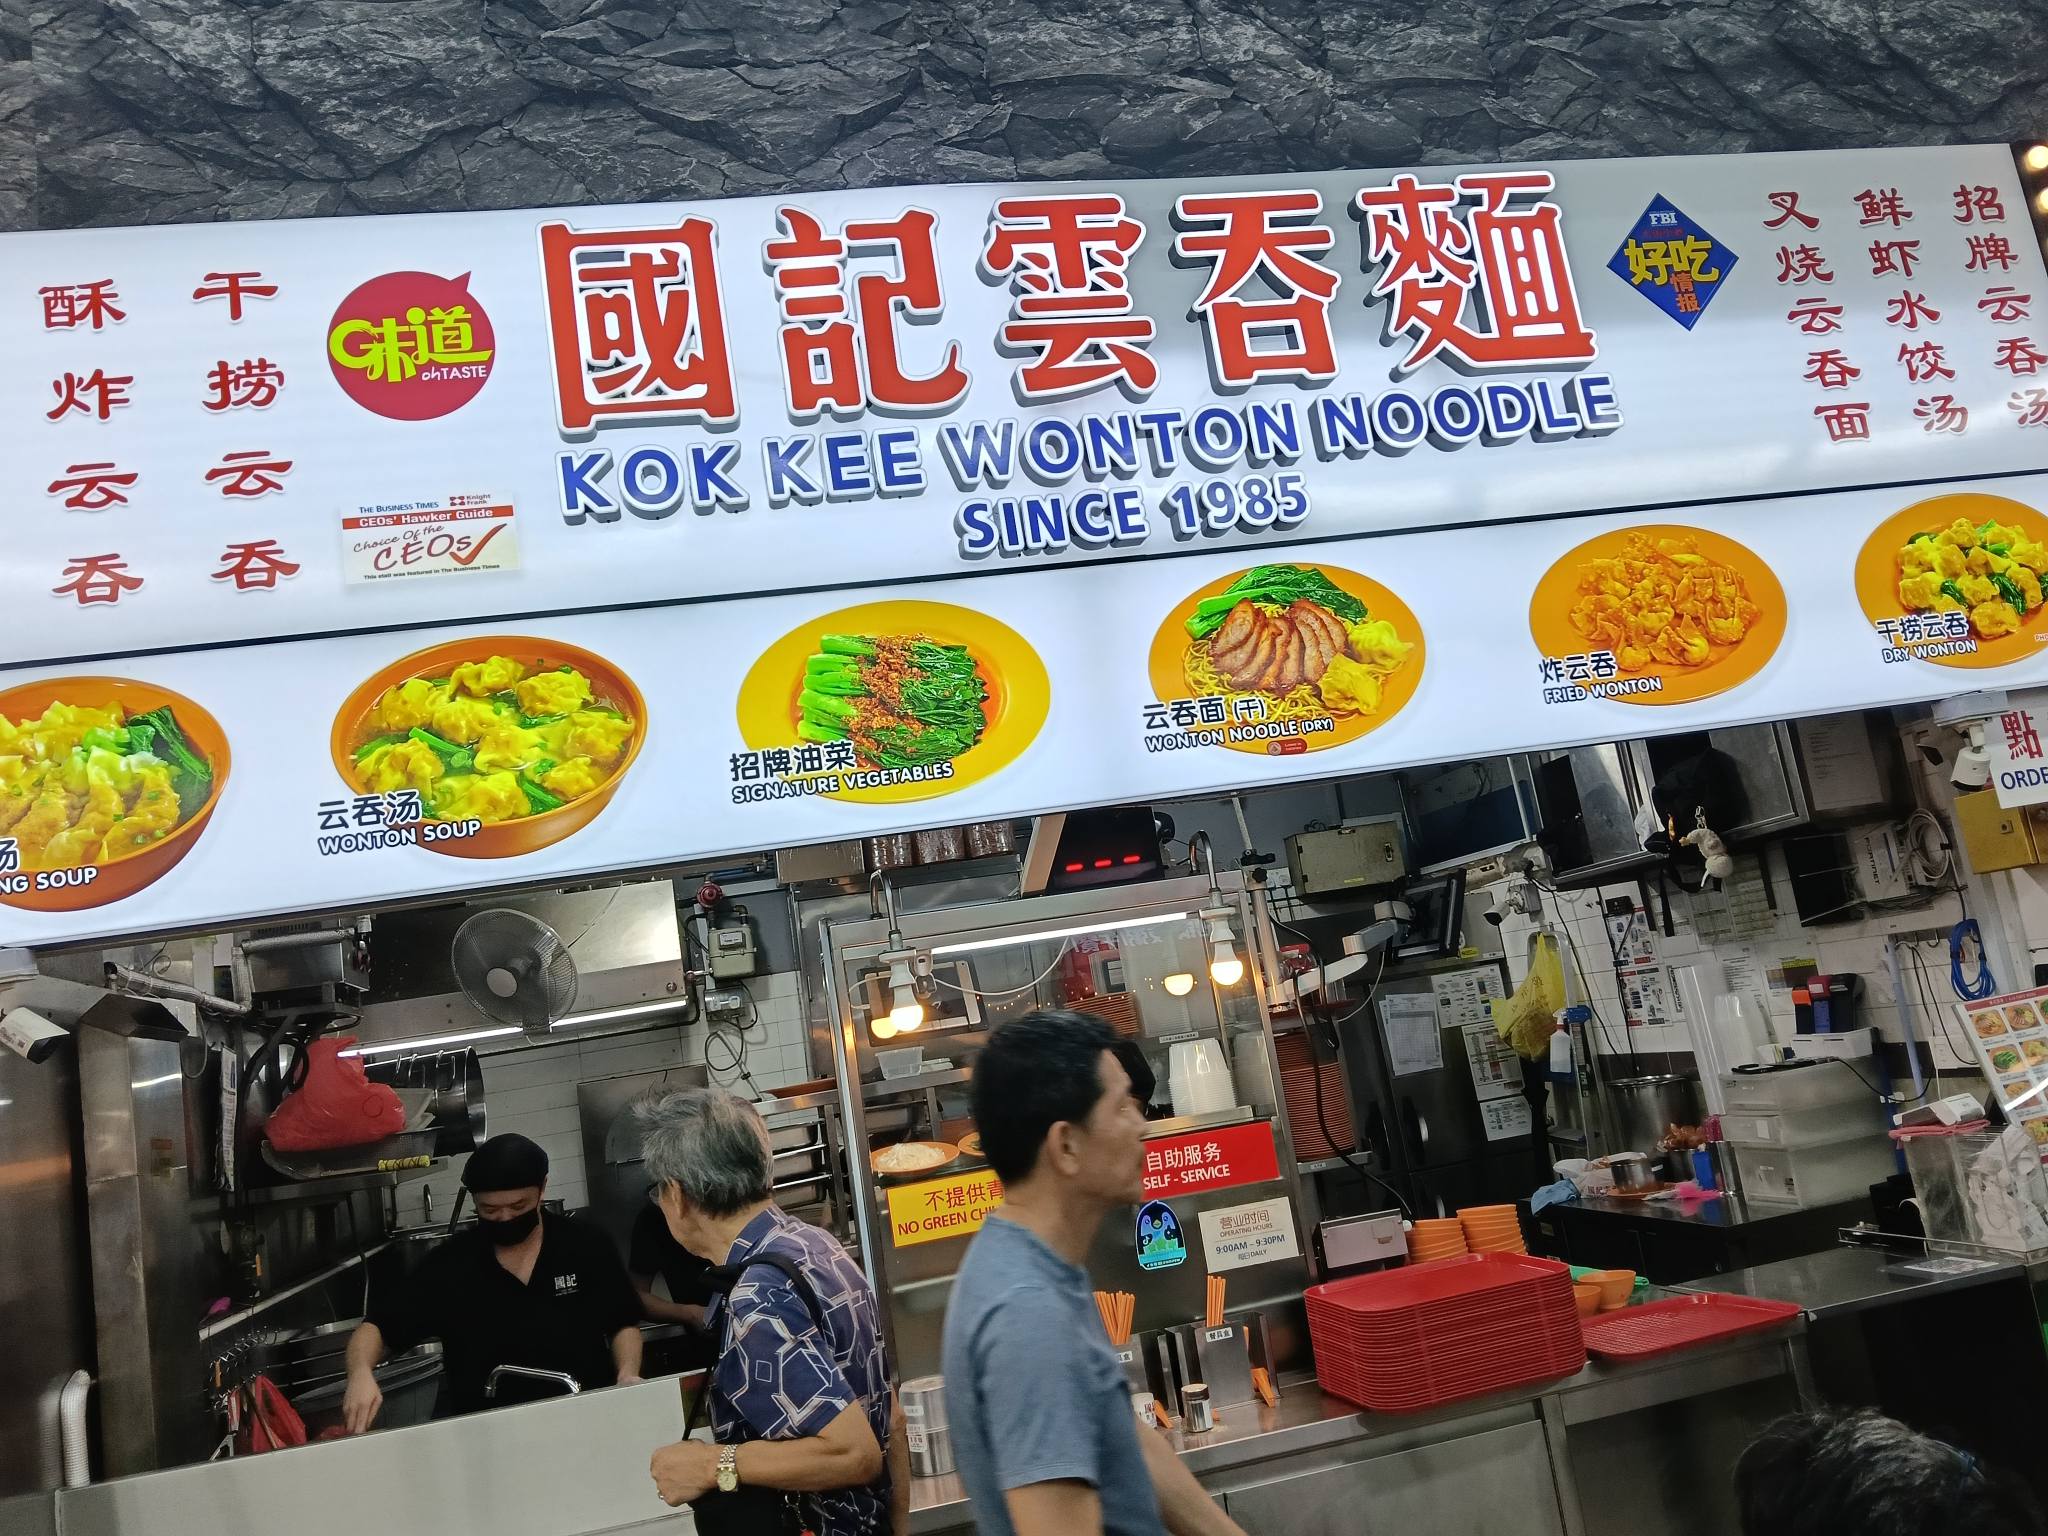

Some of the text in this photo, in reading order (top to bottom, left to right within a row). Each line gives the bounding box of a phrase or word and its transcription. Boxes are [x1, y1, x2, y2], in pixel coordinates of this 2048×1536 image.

[1649, 212, 1678, 225] FBI
[1623, 234, 1720, 285] 好吃
[1670, 271, 1700, 312] 情报
[1763, 191, 1871, 442] 叉烧云吞面
[1854, 187, 1968, 433] 鲜虾水饺汤
[38, 278, 144, 605] 酥炸云吞
[193, 271, 300, 592] 干捞云吞
[561, 375, 1621, 514] KOK KEE WONTON NOODLE
[376, 503, 414, 512] BUSINESS
[401, 513, 453, 523] Hawker
[456, 508, 493, 519] Guide
[963, 475, 1309, 549] SINCE 1985
[353, 525, 445, 552] Choice Of the
[374, 534, 472, 571] CEOs
[1877, 610, 1970, 645] 干捞云吞
[1539, 650, 1616, 684] 炸云吞
[1882, 640, 1977, 664] DRY WONTON
[1544, 676, 1663, 704] FRIED WONTON
[1142, 696, 1226, 732] 云吞面
[1144, 716, 1335, 753] WONTON NOODLE (DRY)
[2000, 710, 2044, 760] 點
[729, 740, 857, 782] 招牌油菜
[732, 761, 954, 804] SIGNATURE VEGETABLES
[316, 790, 422, 831] 云吞汤
[318, 818, 483, 857] WONTON SOUP
[36, 866, 98, 890] SOUP
[1146, 1142, 1221, 1173] 自助服务
[1143, 1173, 1171, 1190] SELF
[1180, 1164, 1231, 1184] SERVICE
[897, 1220, 920, 1236] NO
[923, 1211, 968, 1231] GREEN
[1219, 1222, 1273, 1238] OPERATING HOURS
[1215, 1241, 1248, 1255] 9:00AM
[1255, 1234, 1286, 1248] 9:30PM
